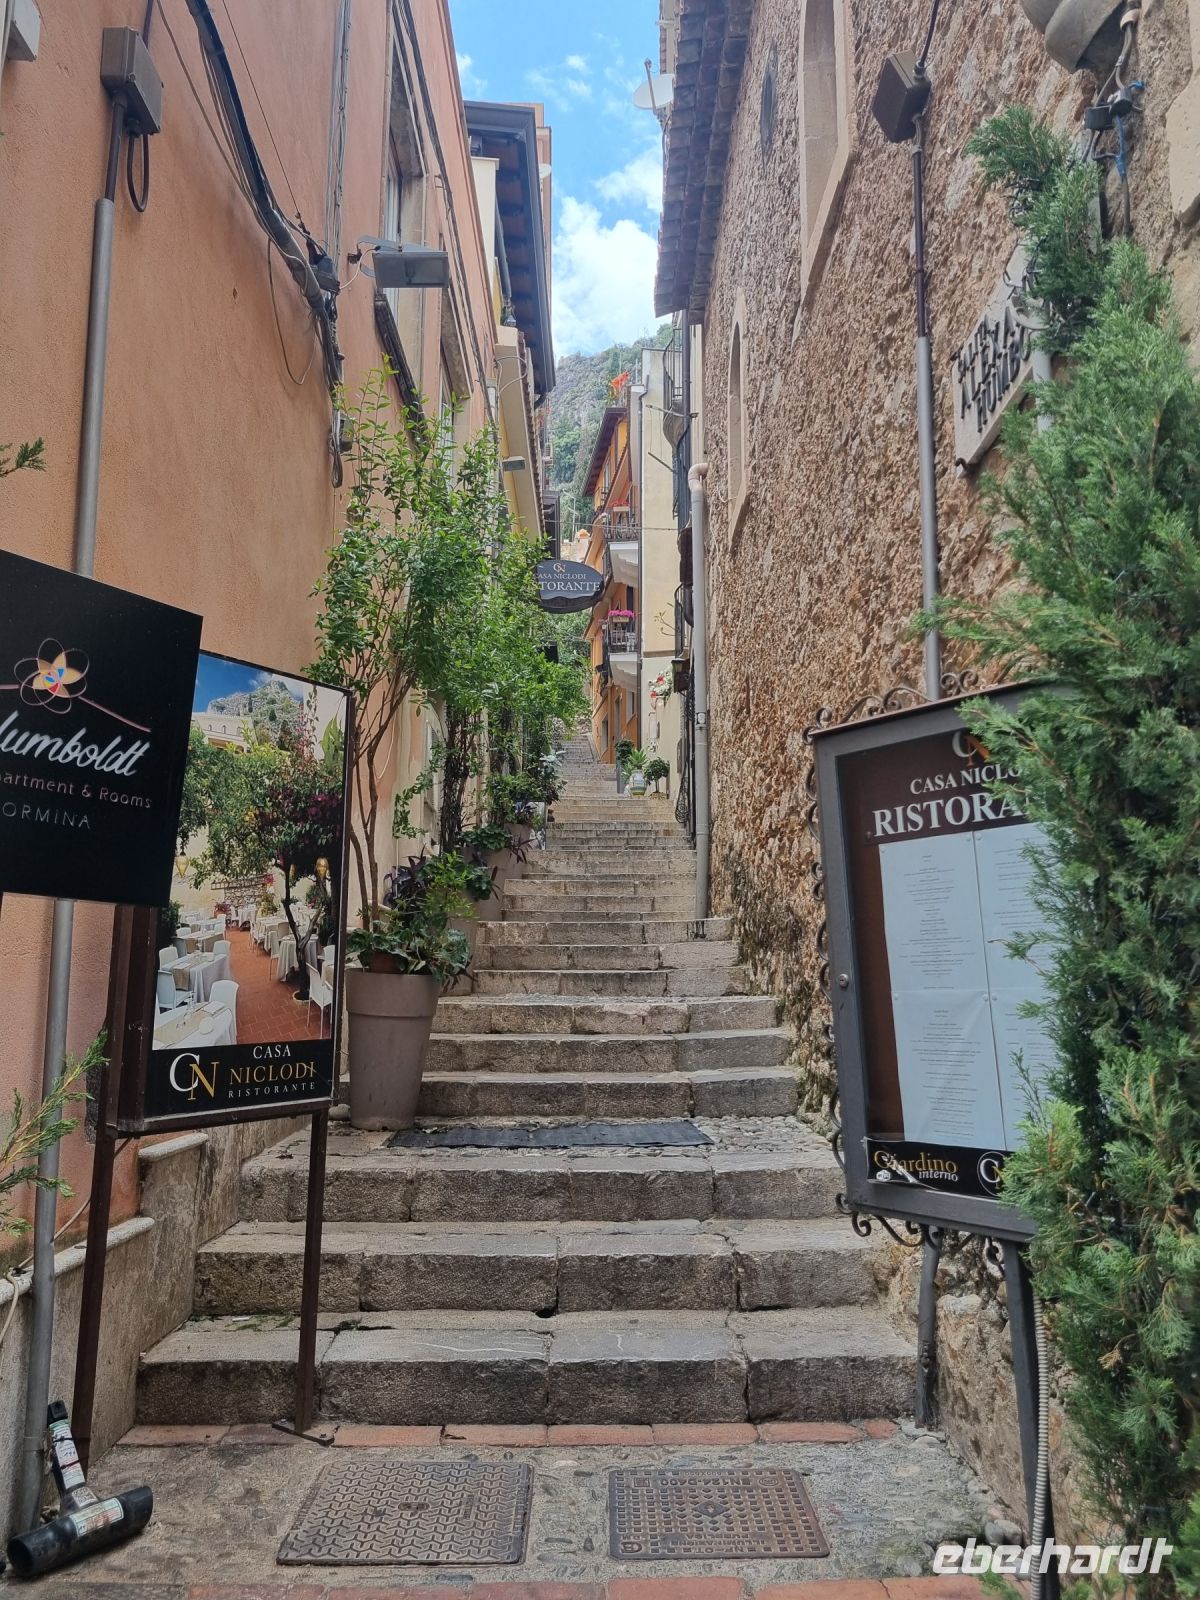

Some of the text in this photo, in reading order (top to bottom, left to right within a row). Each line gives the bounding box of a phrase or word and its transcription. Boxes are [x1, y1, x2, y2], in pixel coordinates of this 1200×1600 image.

[961, 306, 1018, 419] ALEXA
[538, 581, 601, 591] TORANTE
[0, 772, 152, 809] artment & Rooms
[909, 773, 957, 795] CASA
[2, 802, 90, 829] ORMINA
[872, 791, 1027, 837] RISTORA
[252, 1044, 292, 1059] CASA
[229, 1061, 317, 1085] NICLODI
[228, 1082, 316, 1099] RISTORANTE
[918, 1168, 958, 1182] interno
